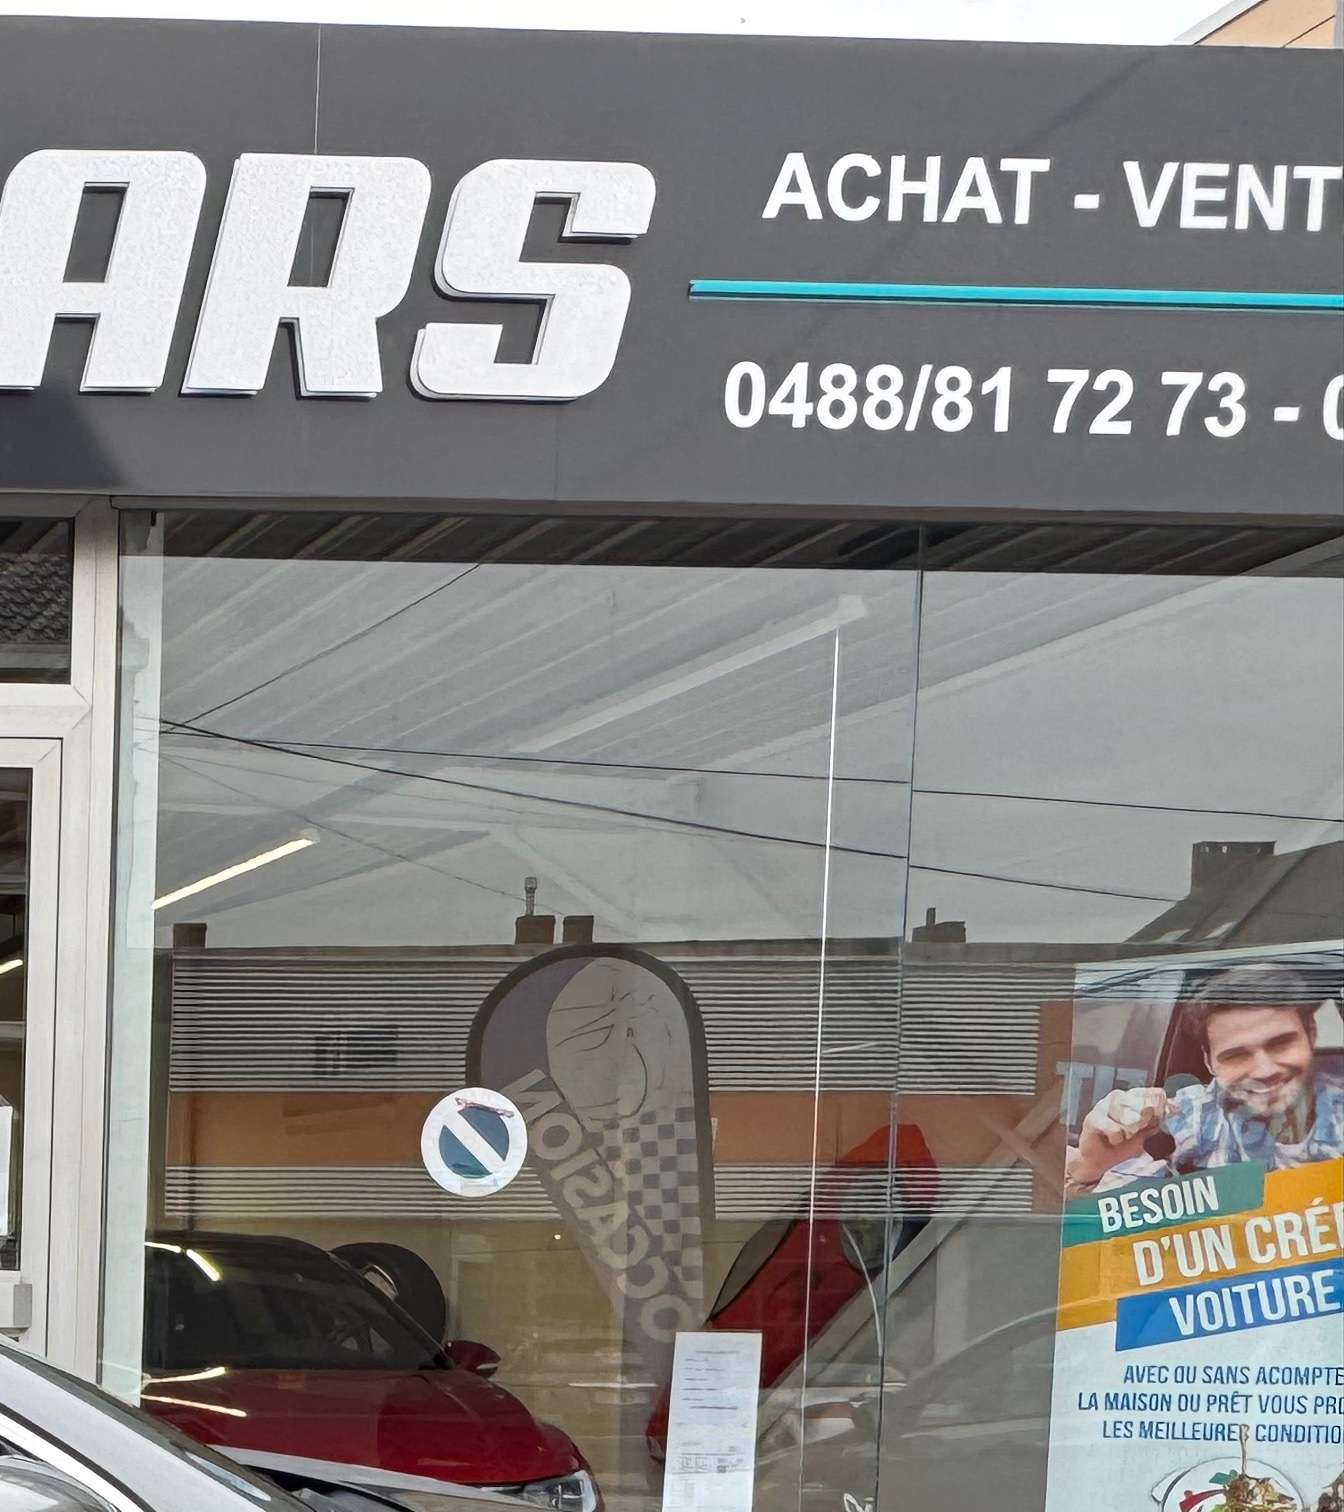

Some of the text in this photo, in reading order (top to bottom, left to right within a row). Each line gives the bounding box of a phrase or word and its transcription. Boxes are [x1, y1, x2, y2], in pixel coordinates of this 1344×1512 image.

[761, 152, 1344, 232] ACHAT - VENT
[723, 360, 1013, 433] 0488/81
[1046, 367, 1135, 436] 72
[1160, 370, 1247, 439] 73
[1274, 405, 1301, 422] -
[1097, 1175, 1219, 1234] BESOIN
[1168, 1268, 1342, 1336] VOITURE
[1078, 1392, 1099, 1411] LA
[1104, 1392, 1172, 1412] MAISON
[1206, 1390, 1253, 1414] PRÊT
[1258, 1394, 1309, 1415] VOUS
[1123, 1365, 1344, 1386] AVEC OU SANS ACOMPTE
[1103, 1420, 1134, 1439] LES
